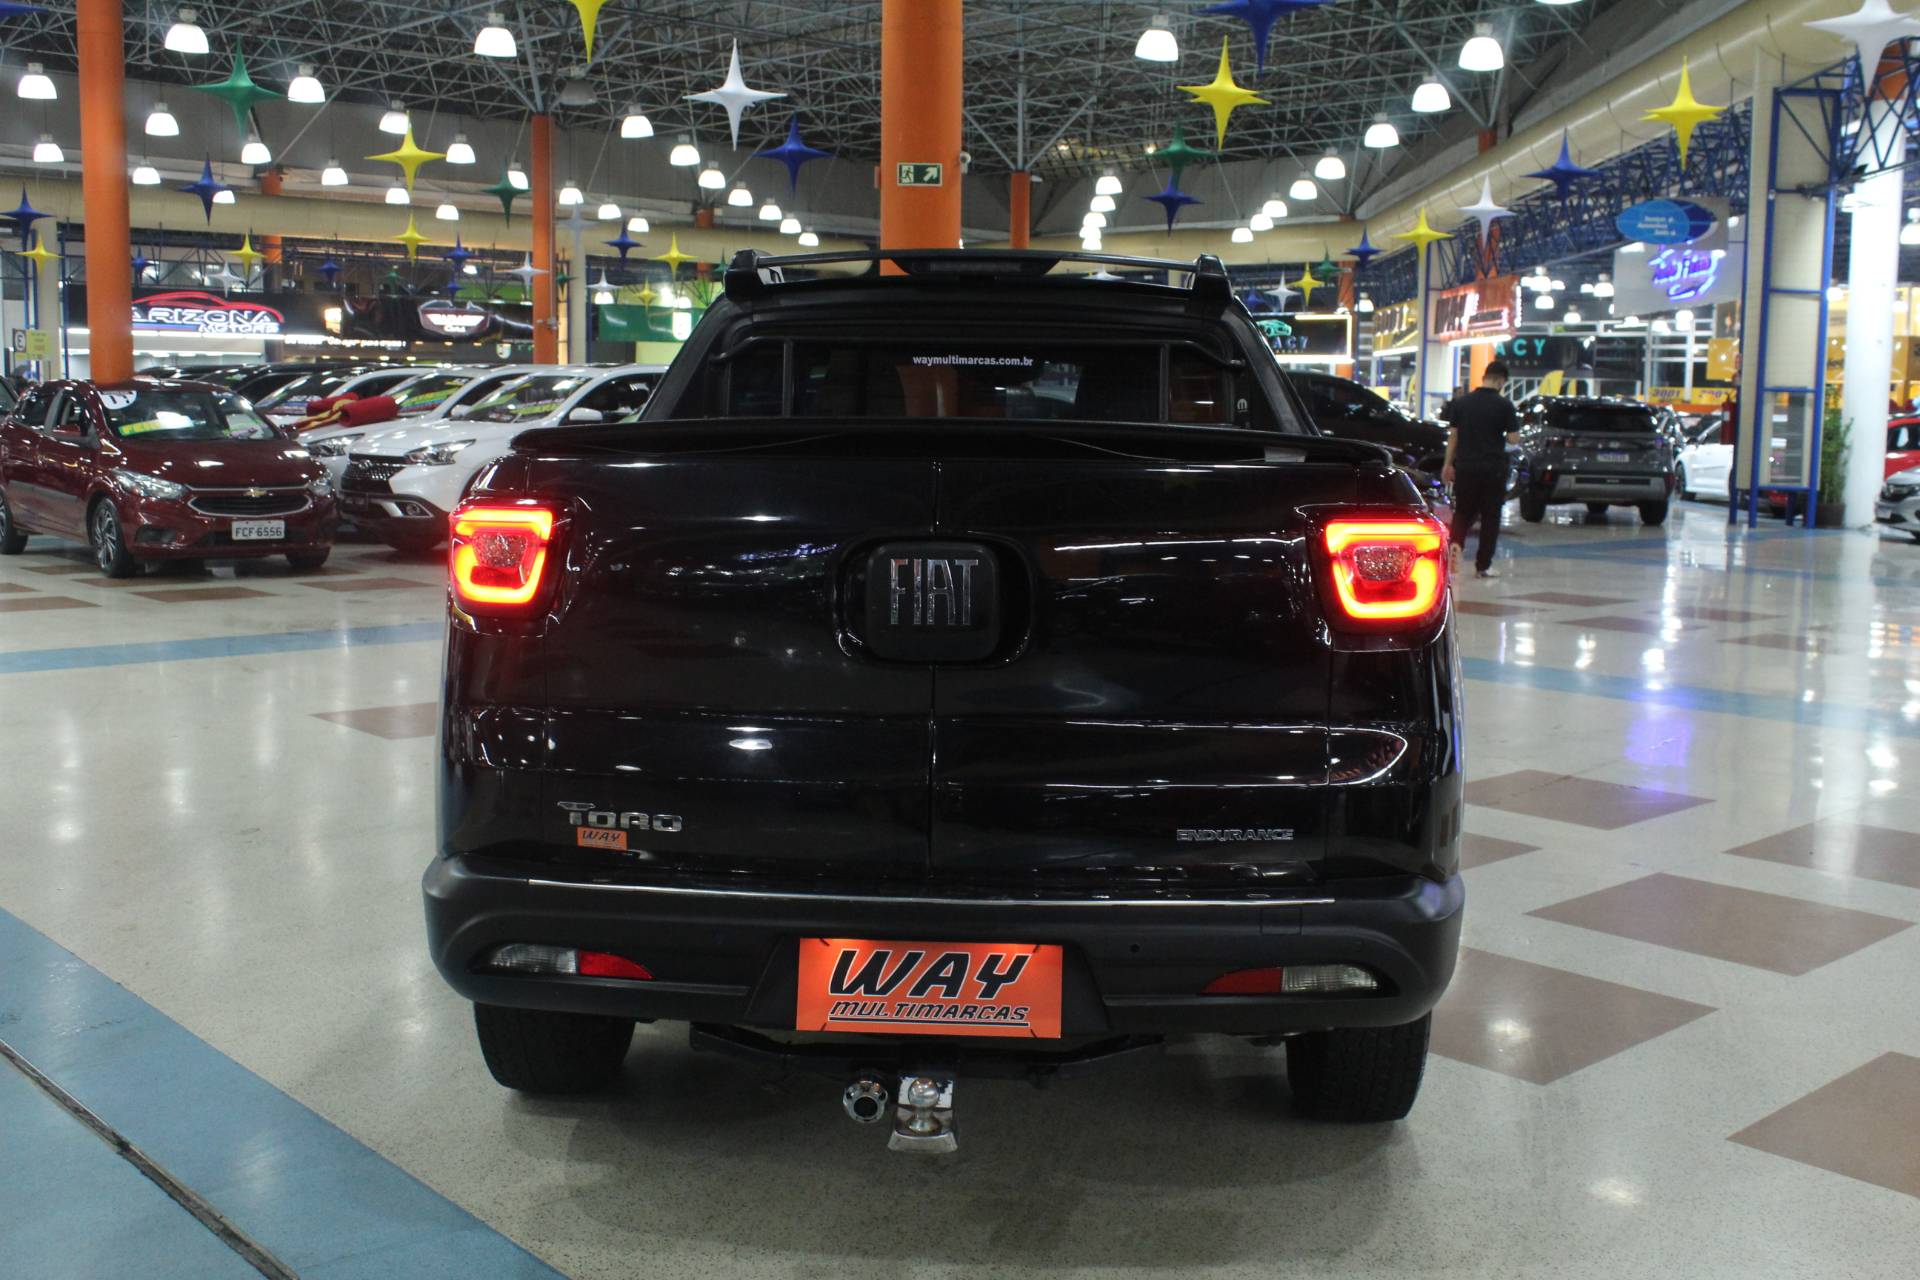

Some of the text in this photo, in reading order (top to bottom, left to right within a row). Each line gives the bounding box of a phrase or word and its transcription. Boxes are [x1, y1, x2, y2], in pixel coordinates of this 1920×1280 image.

[912, 354, 1034, 366] waymultimarcas.com.br
[890, 558, 979, 625] FIAT
[556, 801, 683, 832] TORO
[582, 830, 621, 842] WAY
[1176, 828, 1294, 841] ENDURANCE
[828, 948, 1032, 1001] WAY
[830, 1000, 1030, 1022] MULTIMARCAS
